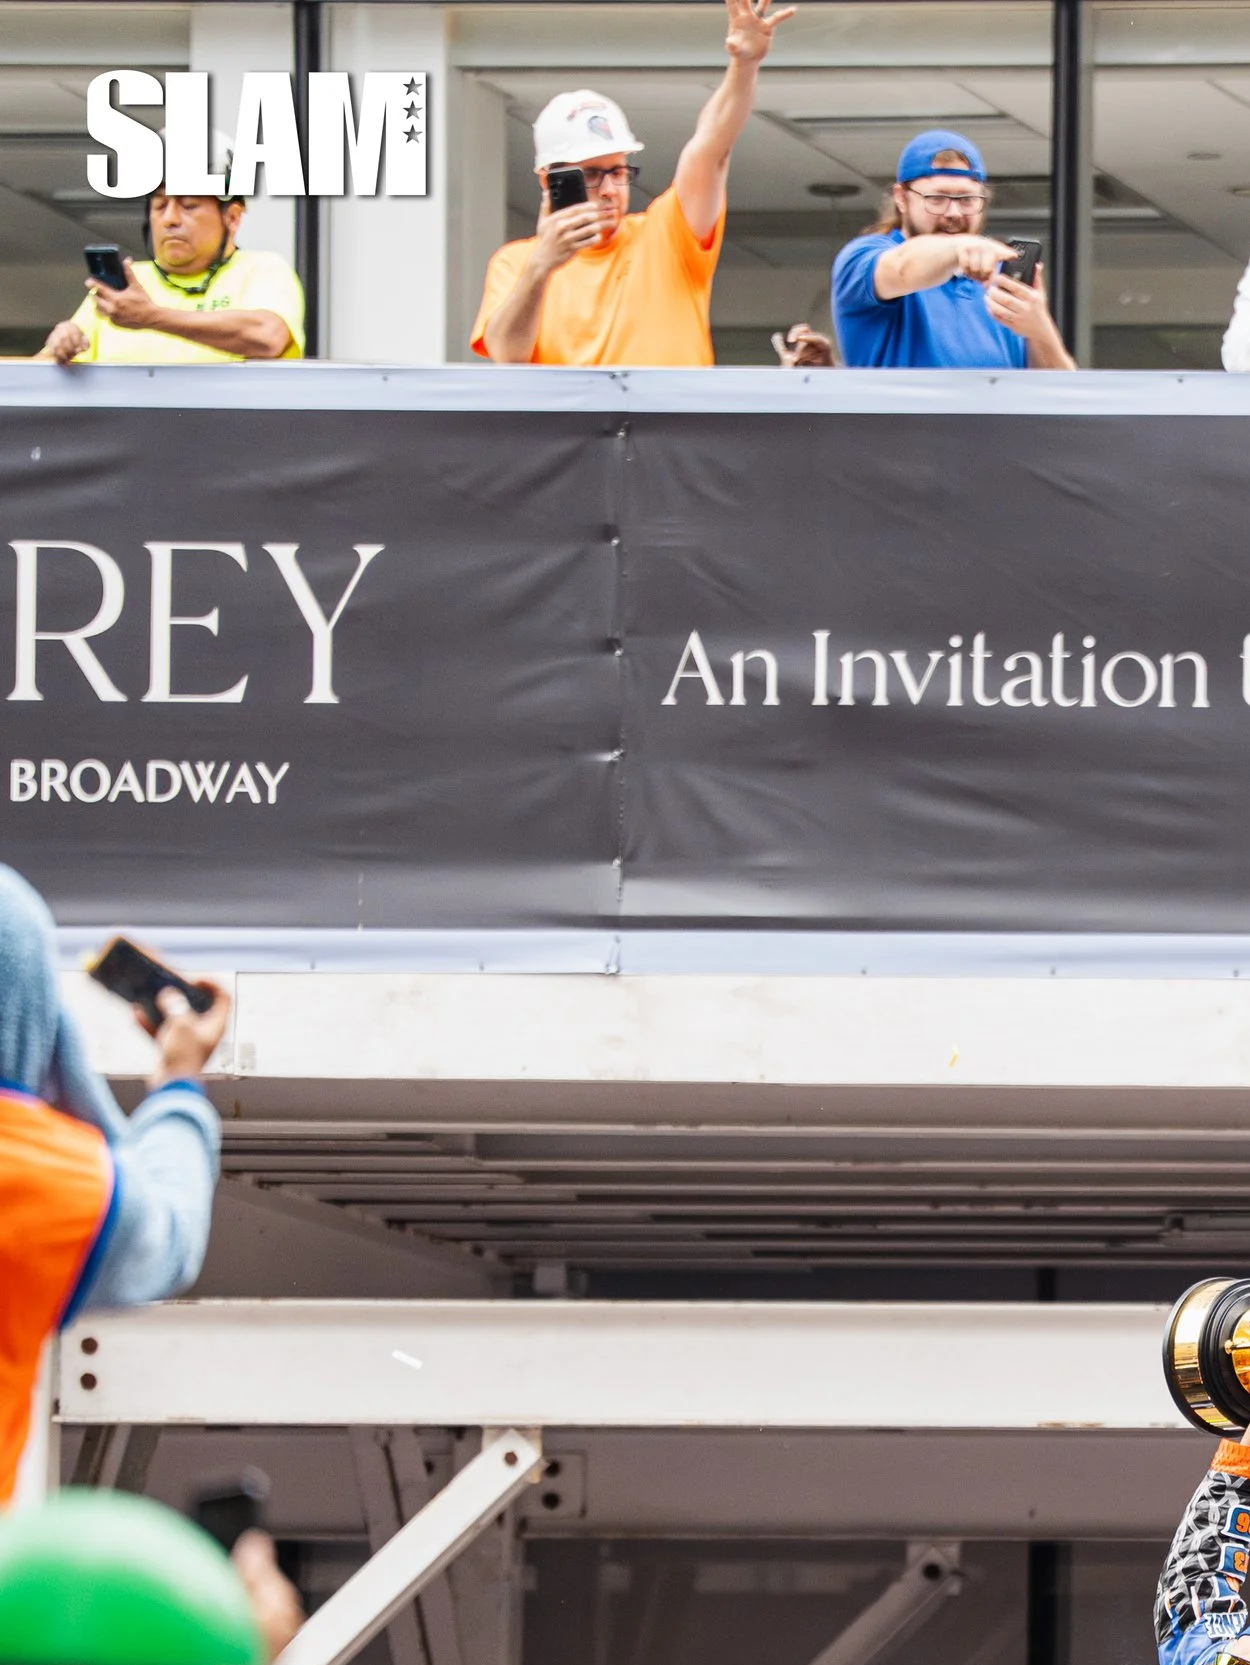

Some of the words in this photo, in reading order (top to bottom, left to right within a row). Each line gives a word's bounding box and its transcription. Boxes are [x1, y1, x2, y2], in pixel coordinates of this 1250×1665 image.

[7, 539, 384, 704] REY
[661, 631, 780, 706] An
[812, 629, 1210, 708] Invitation
[10, 759, 290, 805] BROADWAY
[1232, 1551, 1250, 1575] 3
